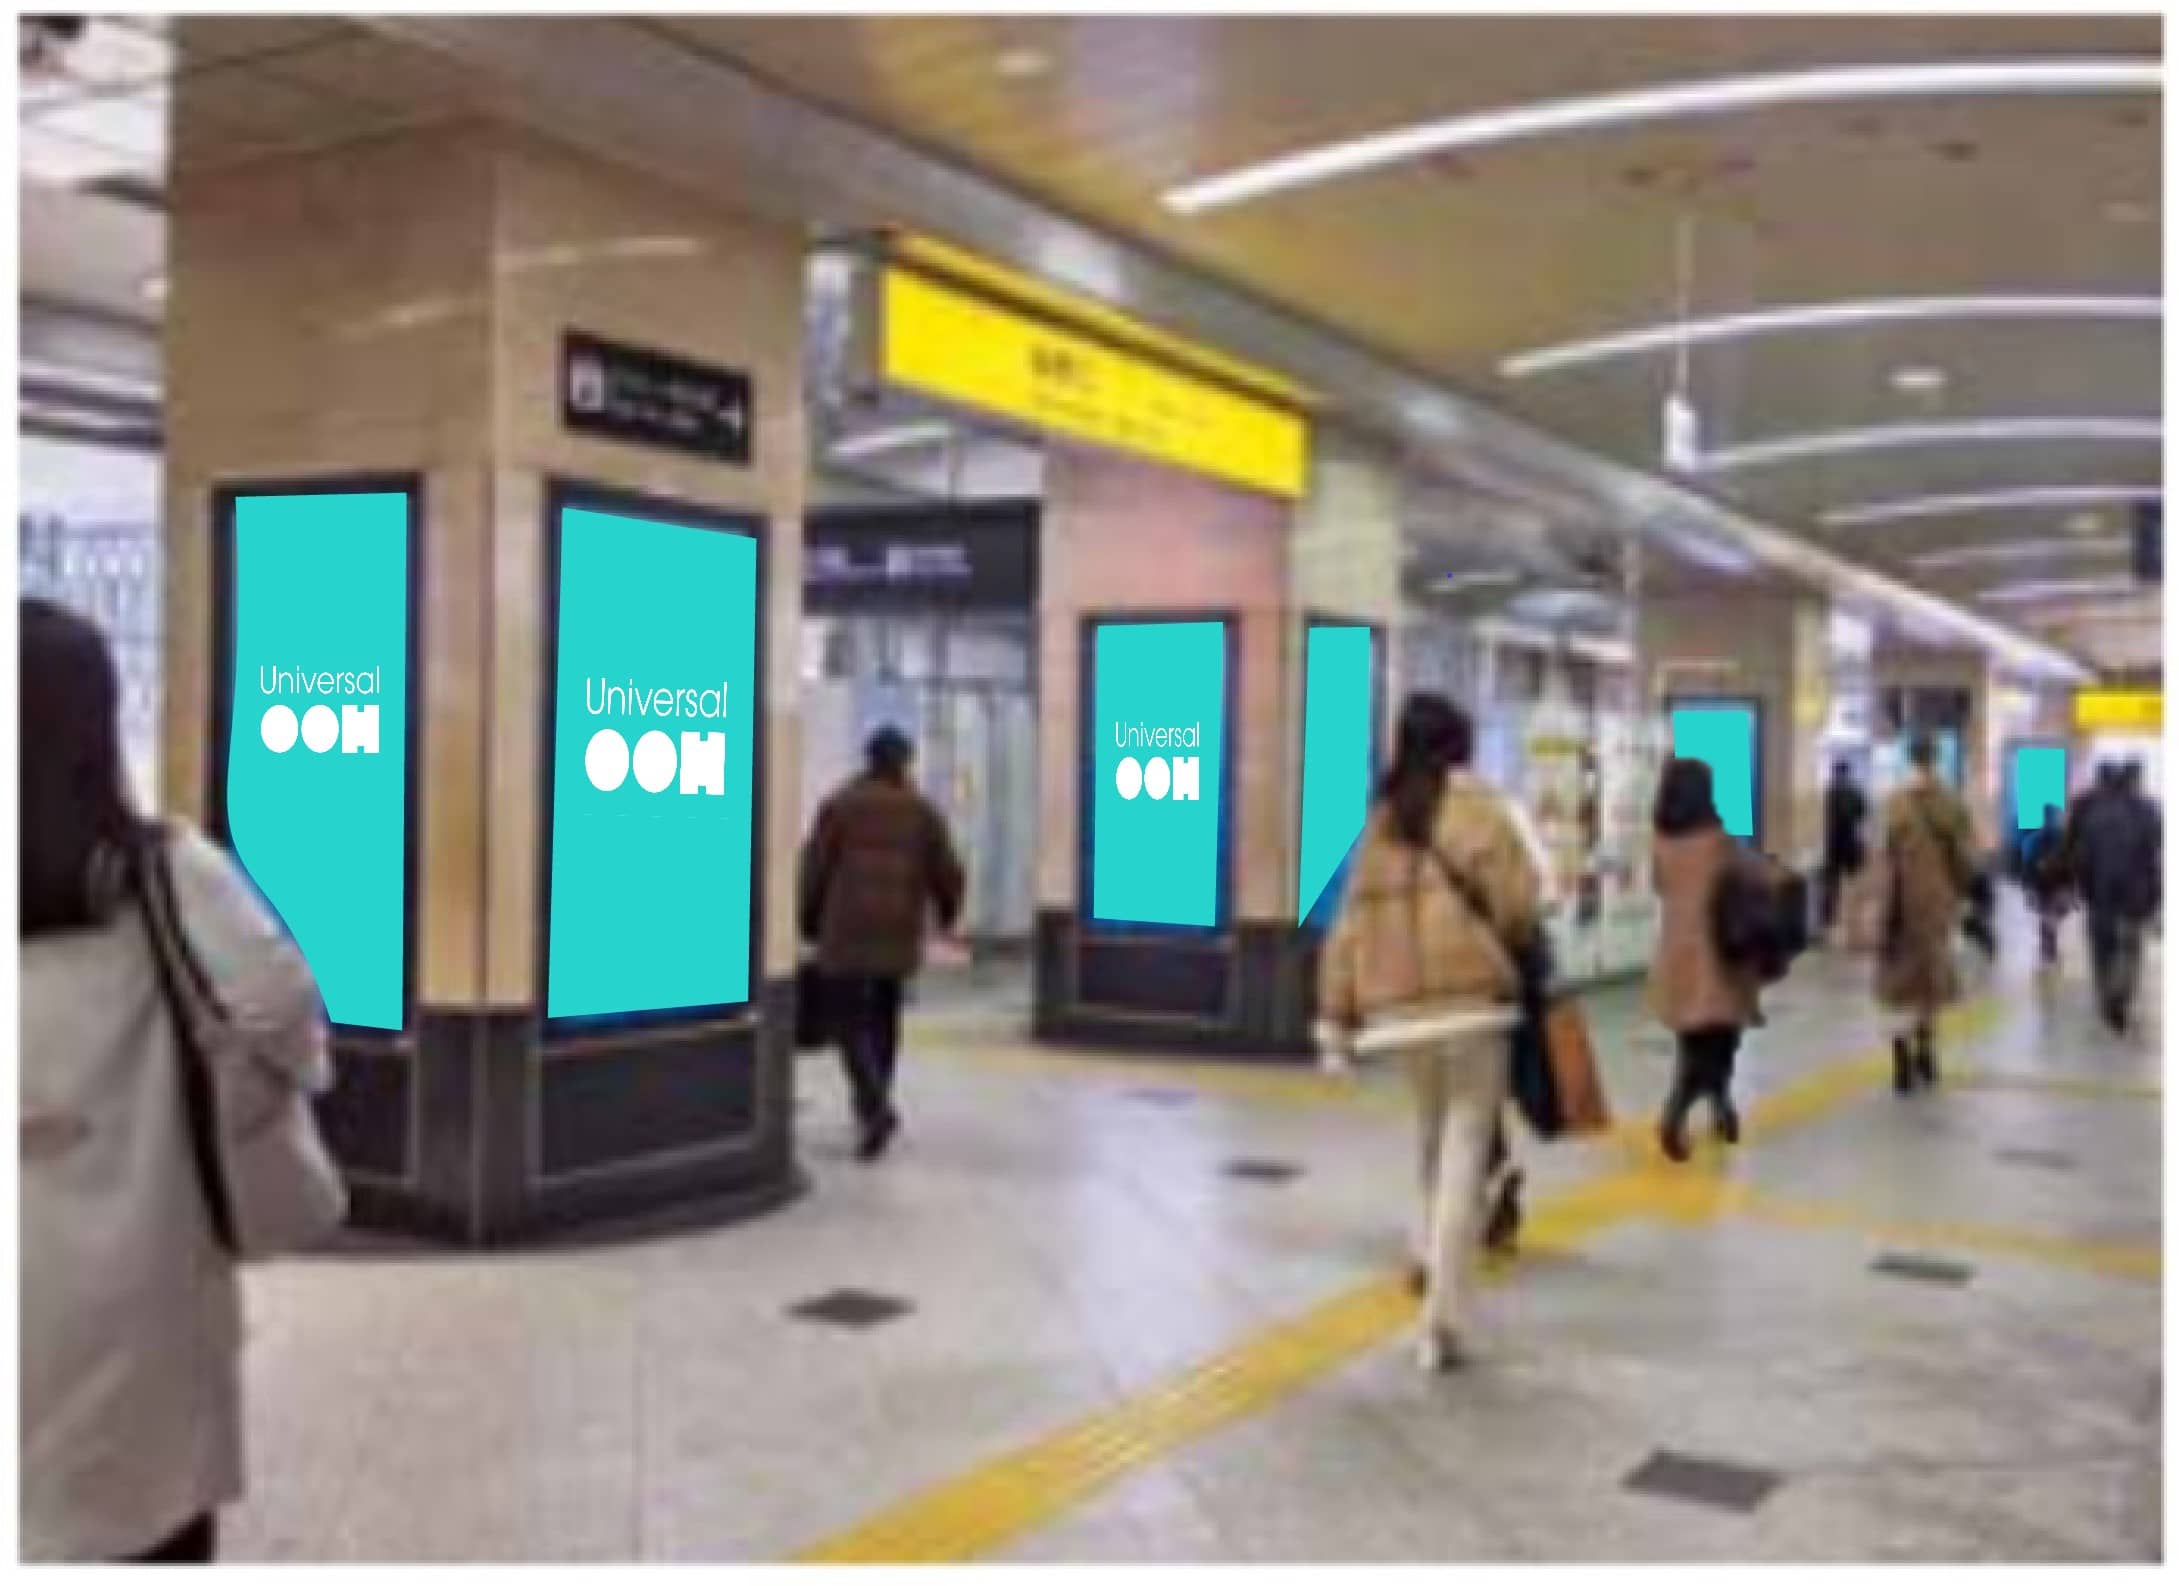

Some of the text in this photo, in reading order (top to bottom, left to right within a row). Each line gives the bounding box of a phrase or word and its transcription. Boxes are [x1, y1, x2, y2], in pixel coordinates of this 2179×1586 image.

[260, 665, 380, 695] Universal
[586, 677, 728, 718] Universal
[260, 704, 380, 754] OOH
[1115, 721, 1200, 748] Universal
[584, 728, 726, 796] OOH
[1115, 756, 1200, 801] OOH
